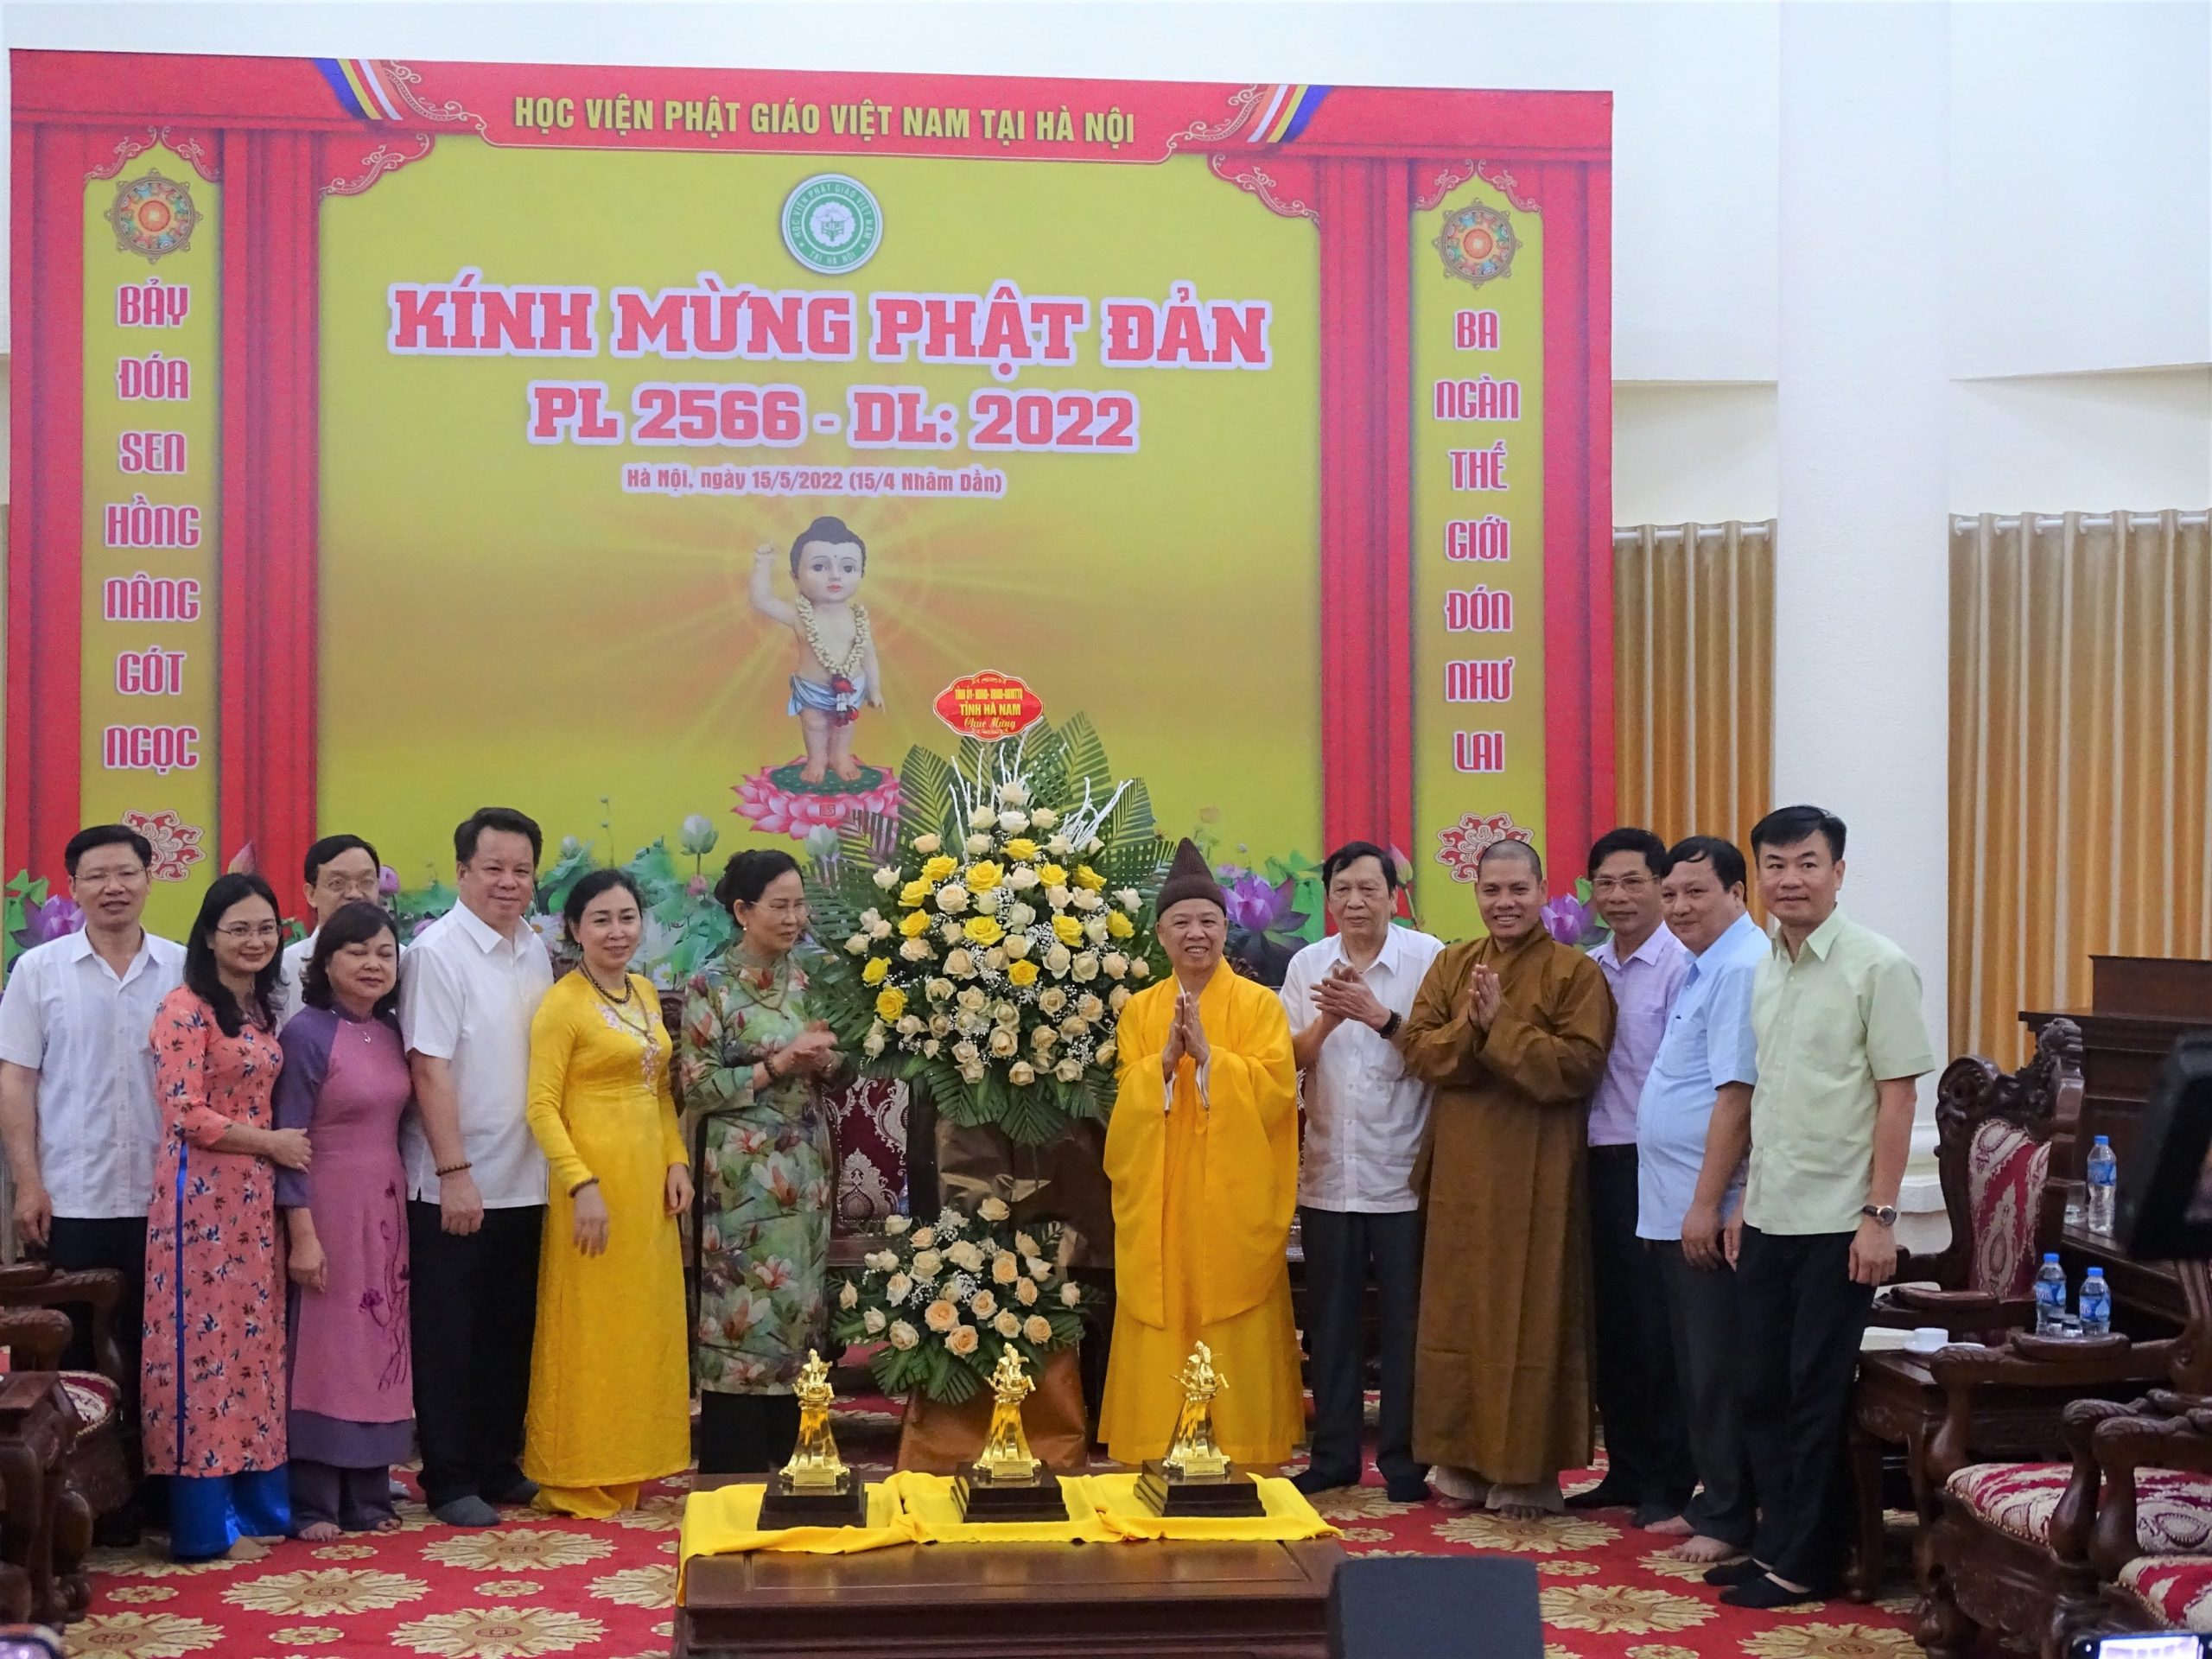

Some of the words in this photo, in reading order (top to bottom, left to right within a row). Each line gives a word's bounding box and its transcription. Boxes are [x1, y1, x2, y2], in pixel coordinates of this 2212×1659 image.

[516, 97, 574, 134] HỌC
[586, 93, 653, 136] VIỆN
[665, 96, 740, 138] PHẬT
[751, 98, 820, 134] GIÁO
[830, 99, 892, 142] VIỆT
[903, 106, 969, 138] NAM
[981, 109, 1025, 146] TẠI
[1037, 105, 1075, 141] HÀ
[1085, 107, 1134, 149] NỘI
[119, 278, 188, 325] BẢY
[394, 273, 593, 351] KÍNH
[616, 278, 851, 354] MỪNG
[874, 286, 1084, 376] PHẬT
[1107, 287, 1266, 364] ĐẢN
[1457, 311, 1498, 348] BA
[118, 353, 188, 398] ĐÓA
[1436, 376, 1519, 418] NGÀN
[534, 387, 618, 439] PL
[638, 389, 801, 441] 2566
[854, 392, 952, 443] DL:
[974, 395, 1134, 447] 2022
[122, 433, 185, 472] SEN
[1450, 442, 1508, 489] THẾ
[627, 467, 651, 487] Hà
[701, 469, 746, 490] ngày
[752, 470, 843, 491] 15/5/2022
[849, 473, 895, 493] (15/4
[902, 473, 953, 492] Nhâm
[961, 470, 1002, 493] Dần)
[107, 495, 200, 545] HỒNG
[1448, 516, 1509, 559] GIỚI
[107, 574, 199, 619] NÂNG
[1446, 587, 1511, 630] ĐÓN
[119, 648, 185, 692] GÓT
[1447, 658, 1513, 700] NHƯ
[960, 701, 982, 715] TỈNH
[983, 701, 997, 715] HÀ
[999, 703, 1021, 715] NAM
[106, 728, 198, 772] NGỌC
[1456, 733, 1503, 770] LAI
